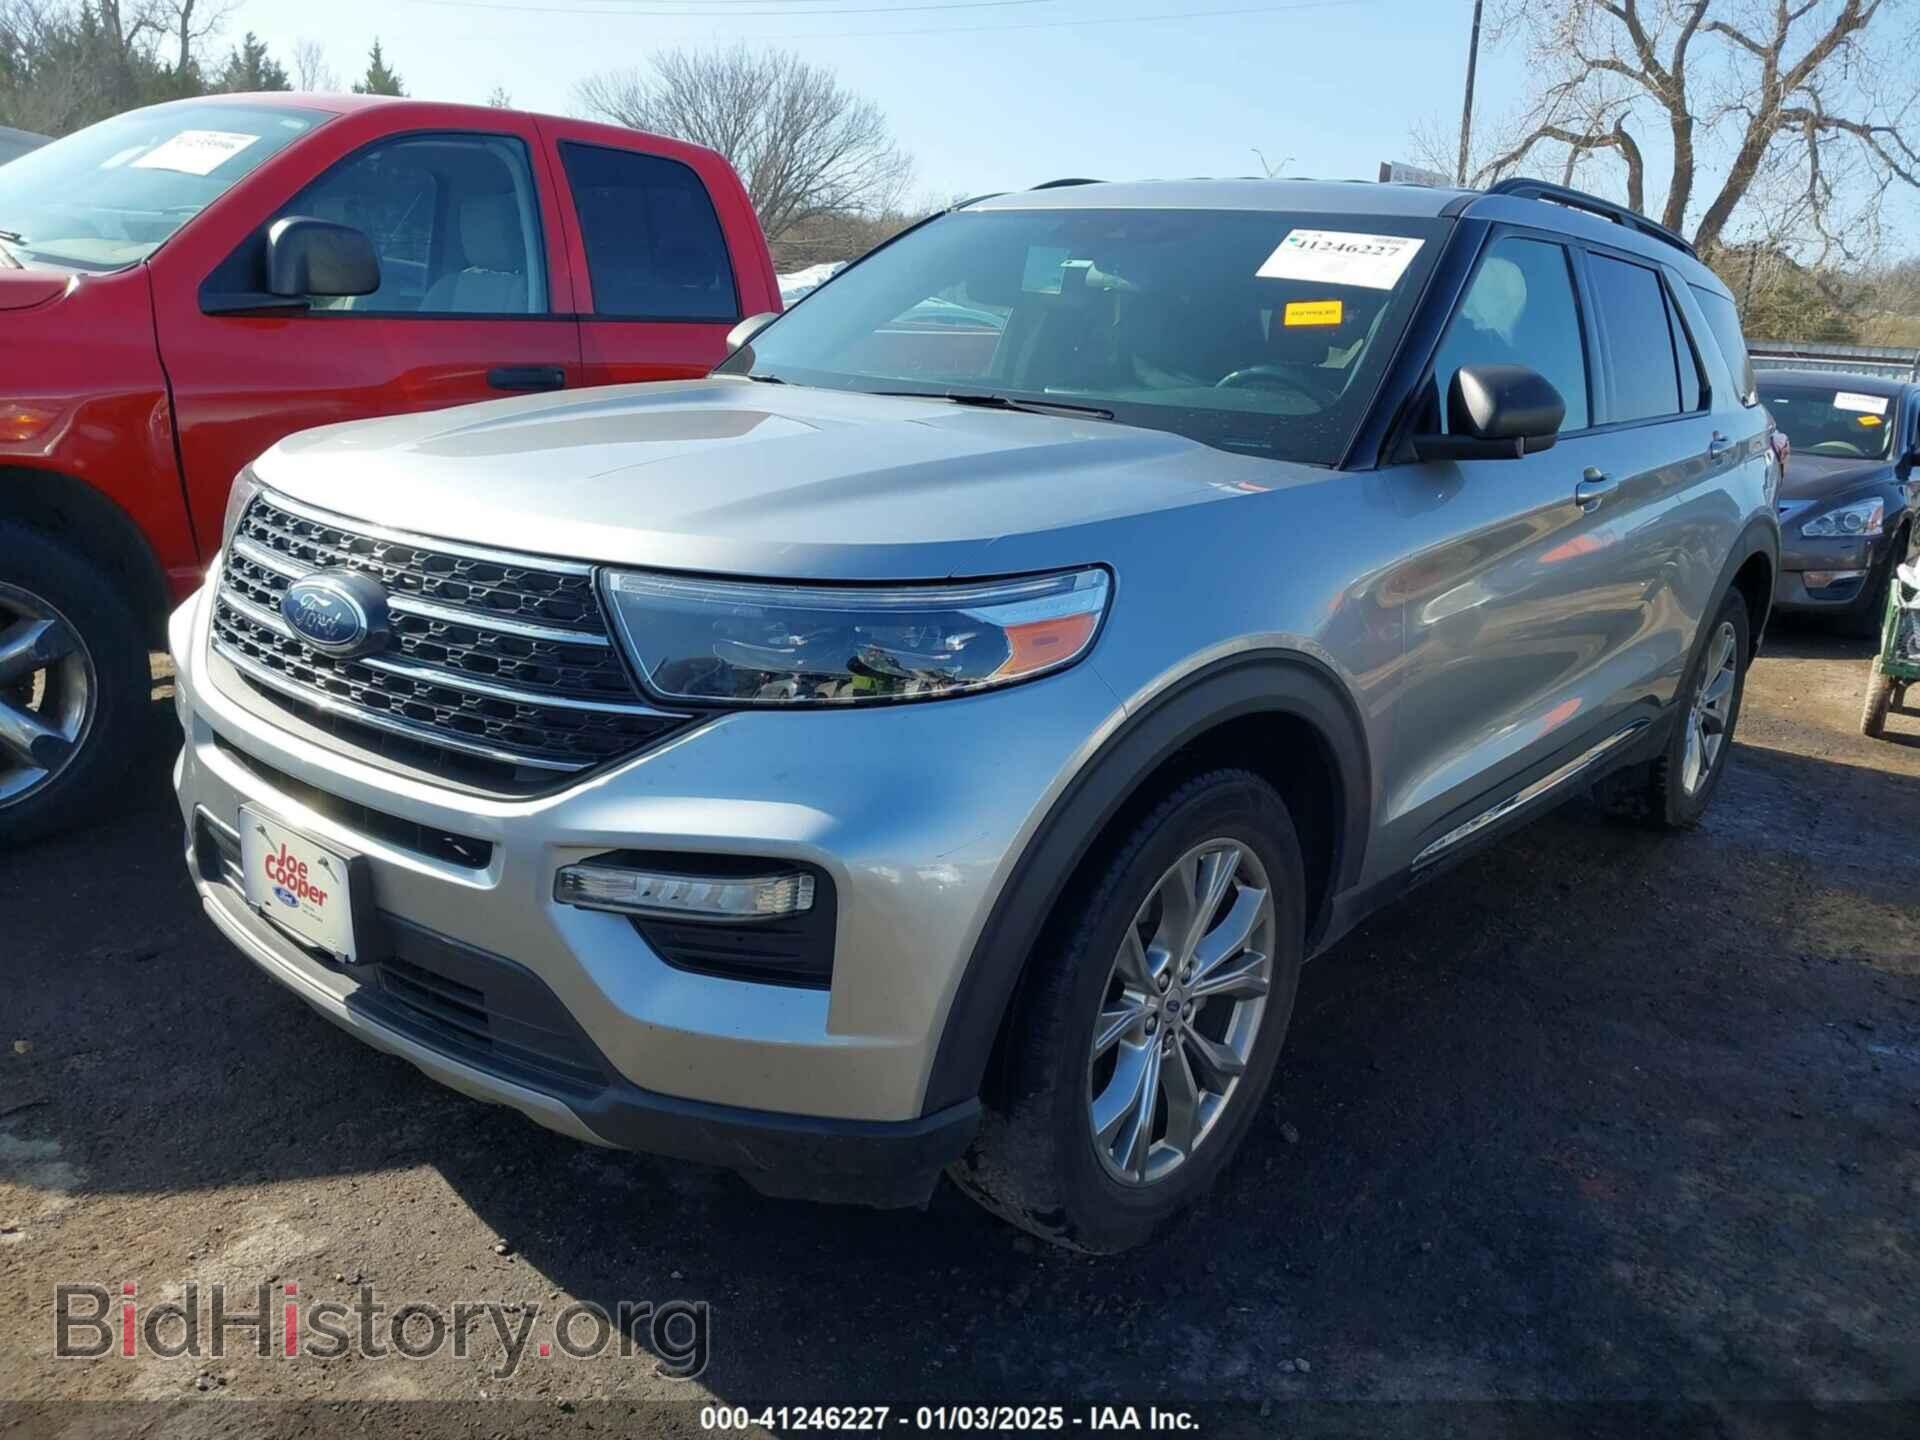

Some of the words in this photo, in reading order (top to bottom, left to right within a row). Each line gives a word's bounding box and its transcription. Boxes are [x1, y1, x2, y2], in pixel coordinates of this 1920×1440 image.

[294, 591, 342, 635] Ford
[265, 853, 328, 907] Cooper
[278, 842, 309, 879] Joe
